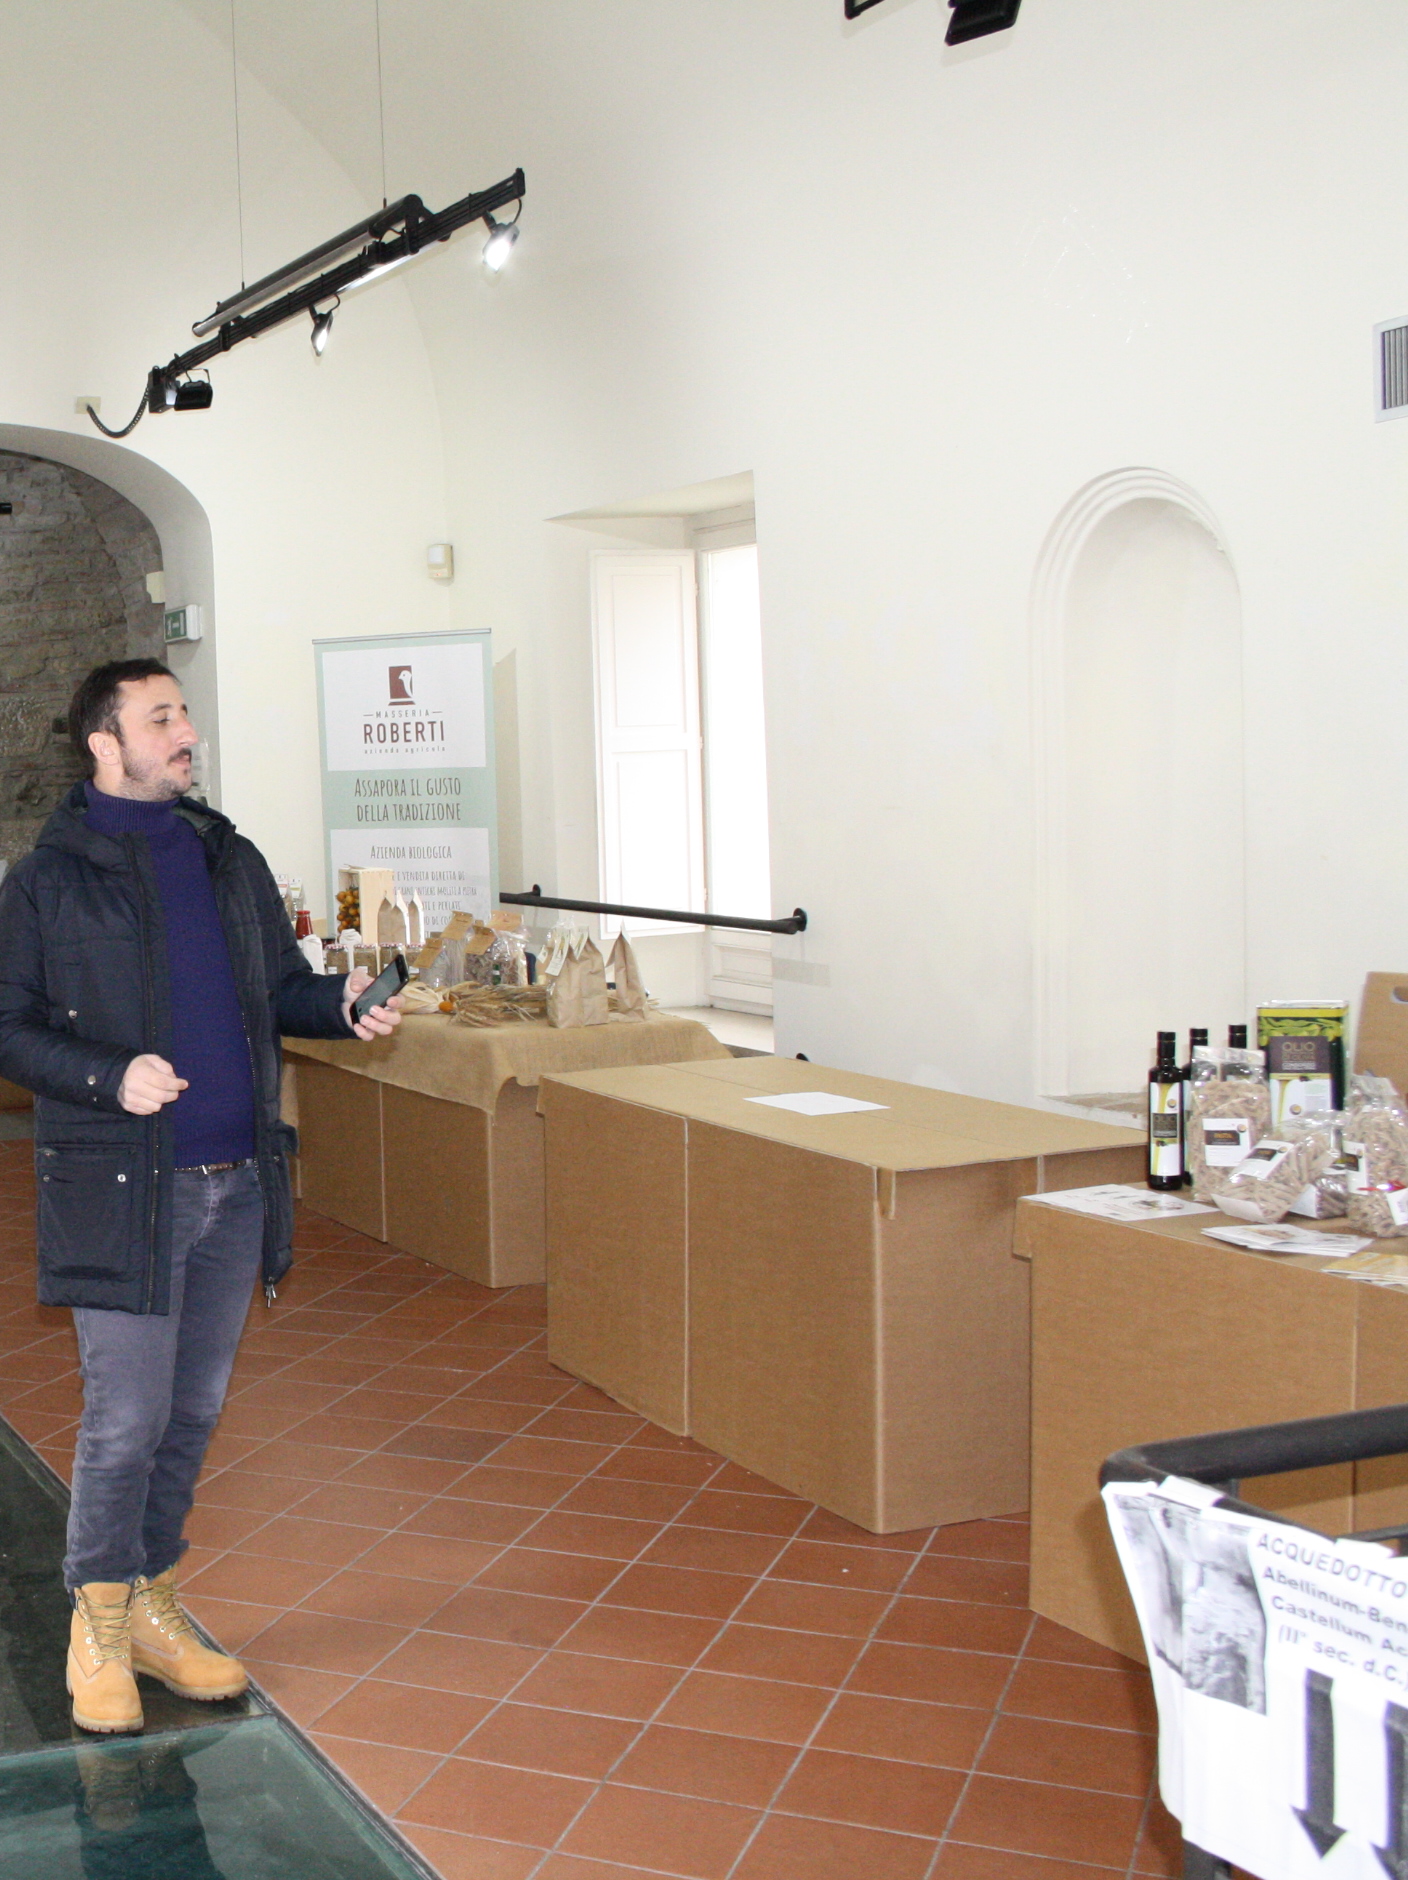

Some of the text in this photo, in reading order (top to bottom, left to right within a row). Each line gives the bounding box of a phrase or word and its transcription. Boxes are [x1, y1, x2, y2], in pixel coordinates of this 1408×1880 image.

[375, 709, 430, 719] MASSERIA
[363, 720, 445, 744] ROBERTI
[405, 746, 446, 754] agricola
[354, 777, 461, 798] ASSAPORA IL GUSTO
[356, 802, 461, 822] DELLA TRADIZIONE
[370, 845, 452, 859] AZIENDA BIOLOGICA
[402, 871, 429, 881] VENDITA
[431, 871, 456, 880] DIRETTA
[1282, 1042, 1315, 1051] OLIO
[1257, 1533, 1407, 1598] ACQUEDOTTO
[1271, 1595, 1374, 1644] Castellum
[1312, 1641, 1355, 1666] sec.
